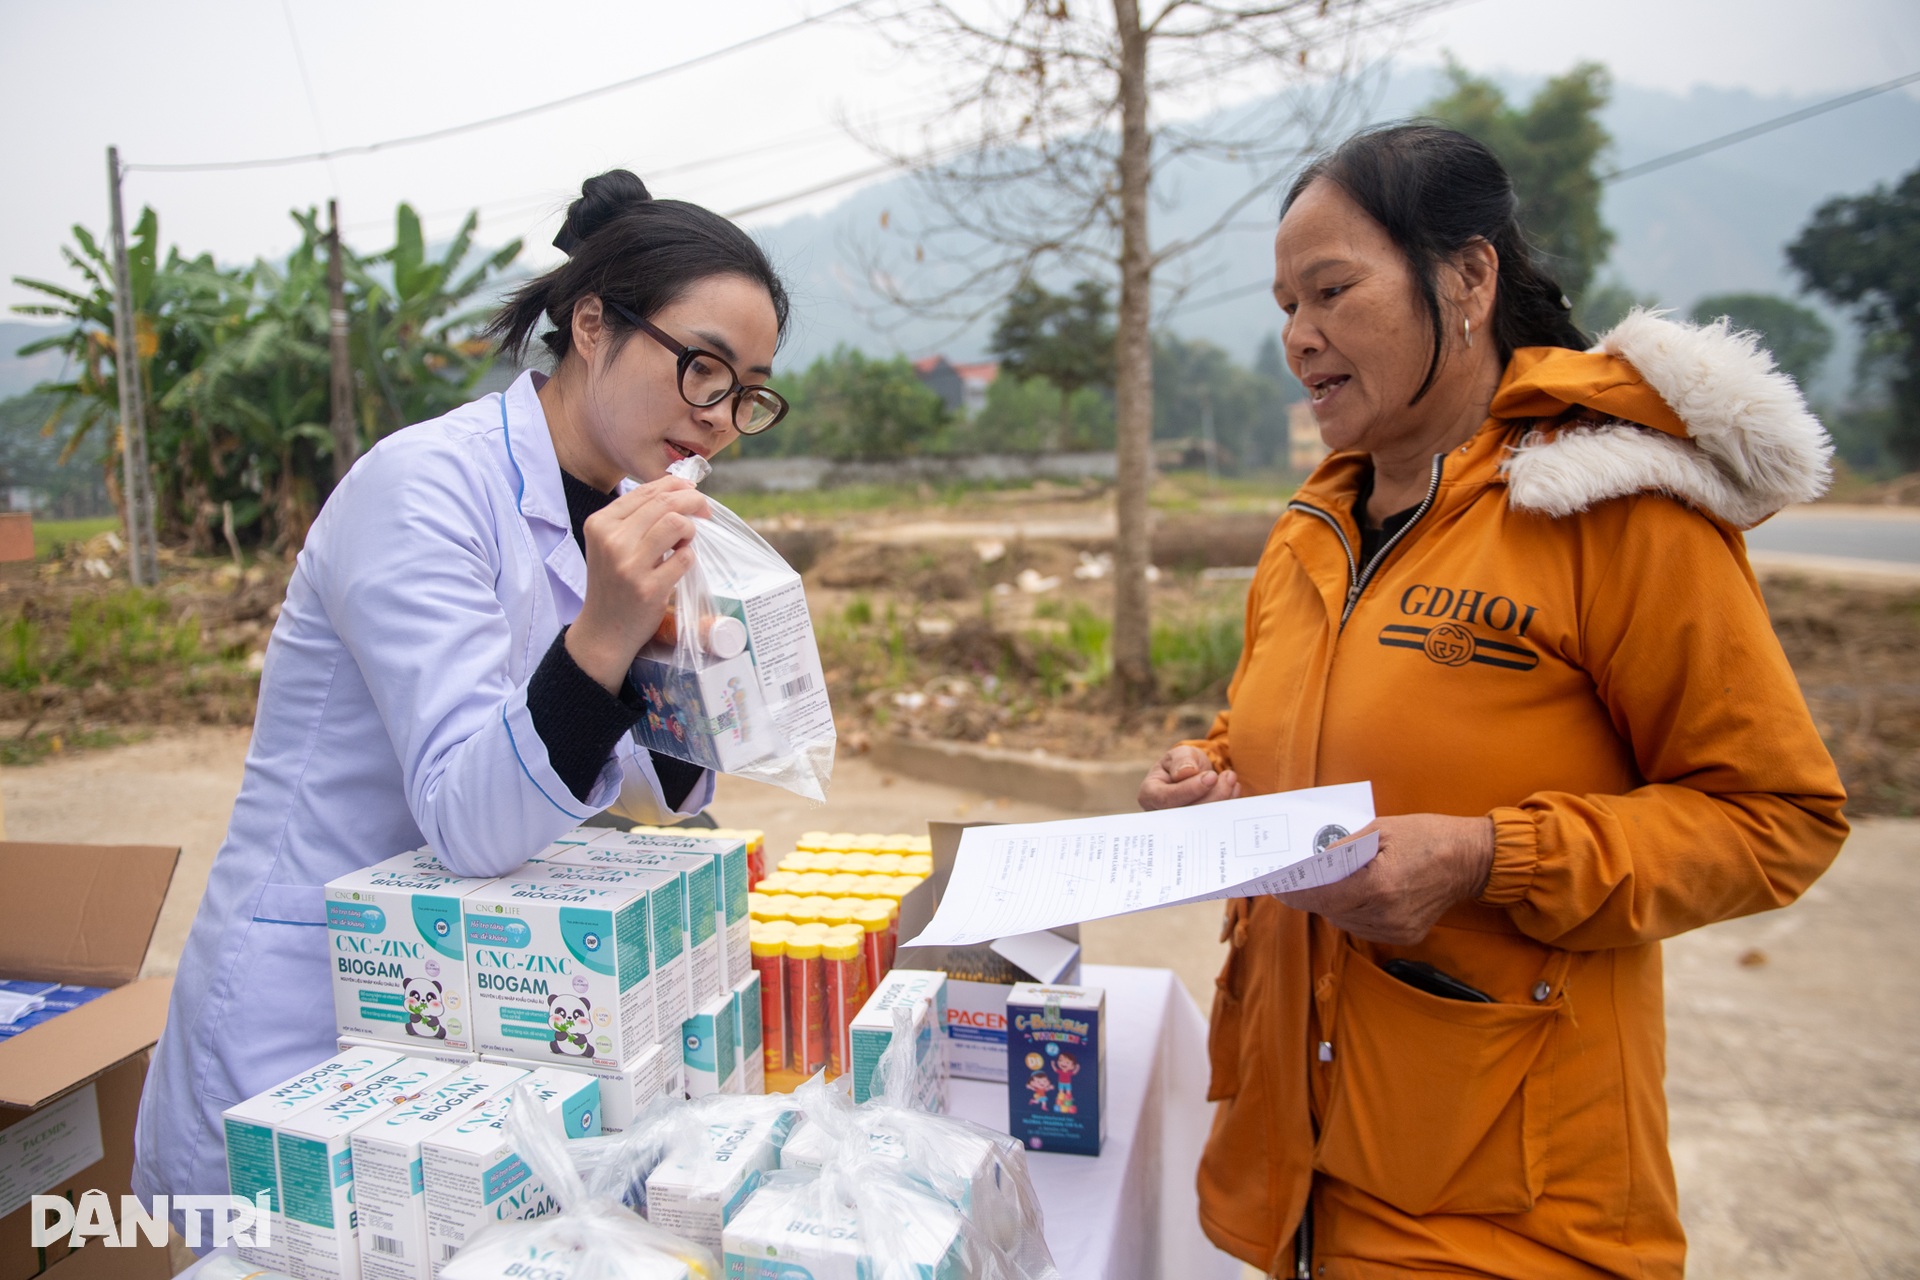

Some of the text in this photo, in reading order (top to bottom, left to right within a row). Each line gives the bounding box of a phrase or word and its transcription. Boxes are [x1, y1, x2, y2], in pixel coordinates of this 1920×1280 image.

[1400, 584, 1540, 637] GDHOI
[627, 839, 696, 849] BIOGAM
[590, 856, 661, 866] BIOGAM
[370, 879, 442, 890] BIOGAM
[550, 872, 623, 883] BIOGAM
[335, 891, 376, 902] CNC LIFE
[512, 890, 588, 903] BIOGAM
[476, 904, 520, 915] CNC LIFE
[336, 934, 425, 960] CNC-ZINC
[338, 957, 405, 979] BIOGAM
[476, 949, 572, 976] CNC-ZINC
[478, 972, 549, 996] BIOGAM
[270, 1063, 344, 1098] BIOGAM
[324, 1075, 398, 1112] BIOGAM
[327, 1071, 429, 1125] CNC-ZINC
[386, 1073, 482, 1126] CNC-ZINC
[419, 1083, 490, 1122] BIOGAM
[786, 1220, 859, 1241] BIOGA
